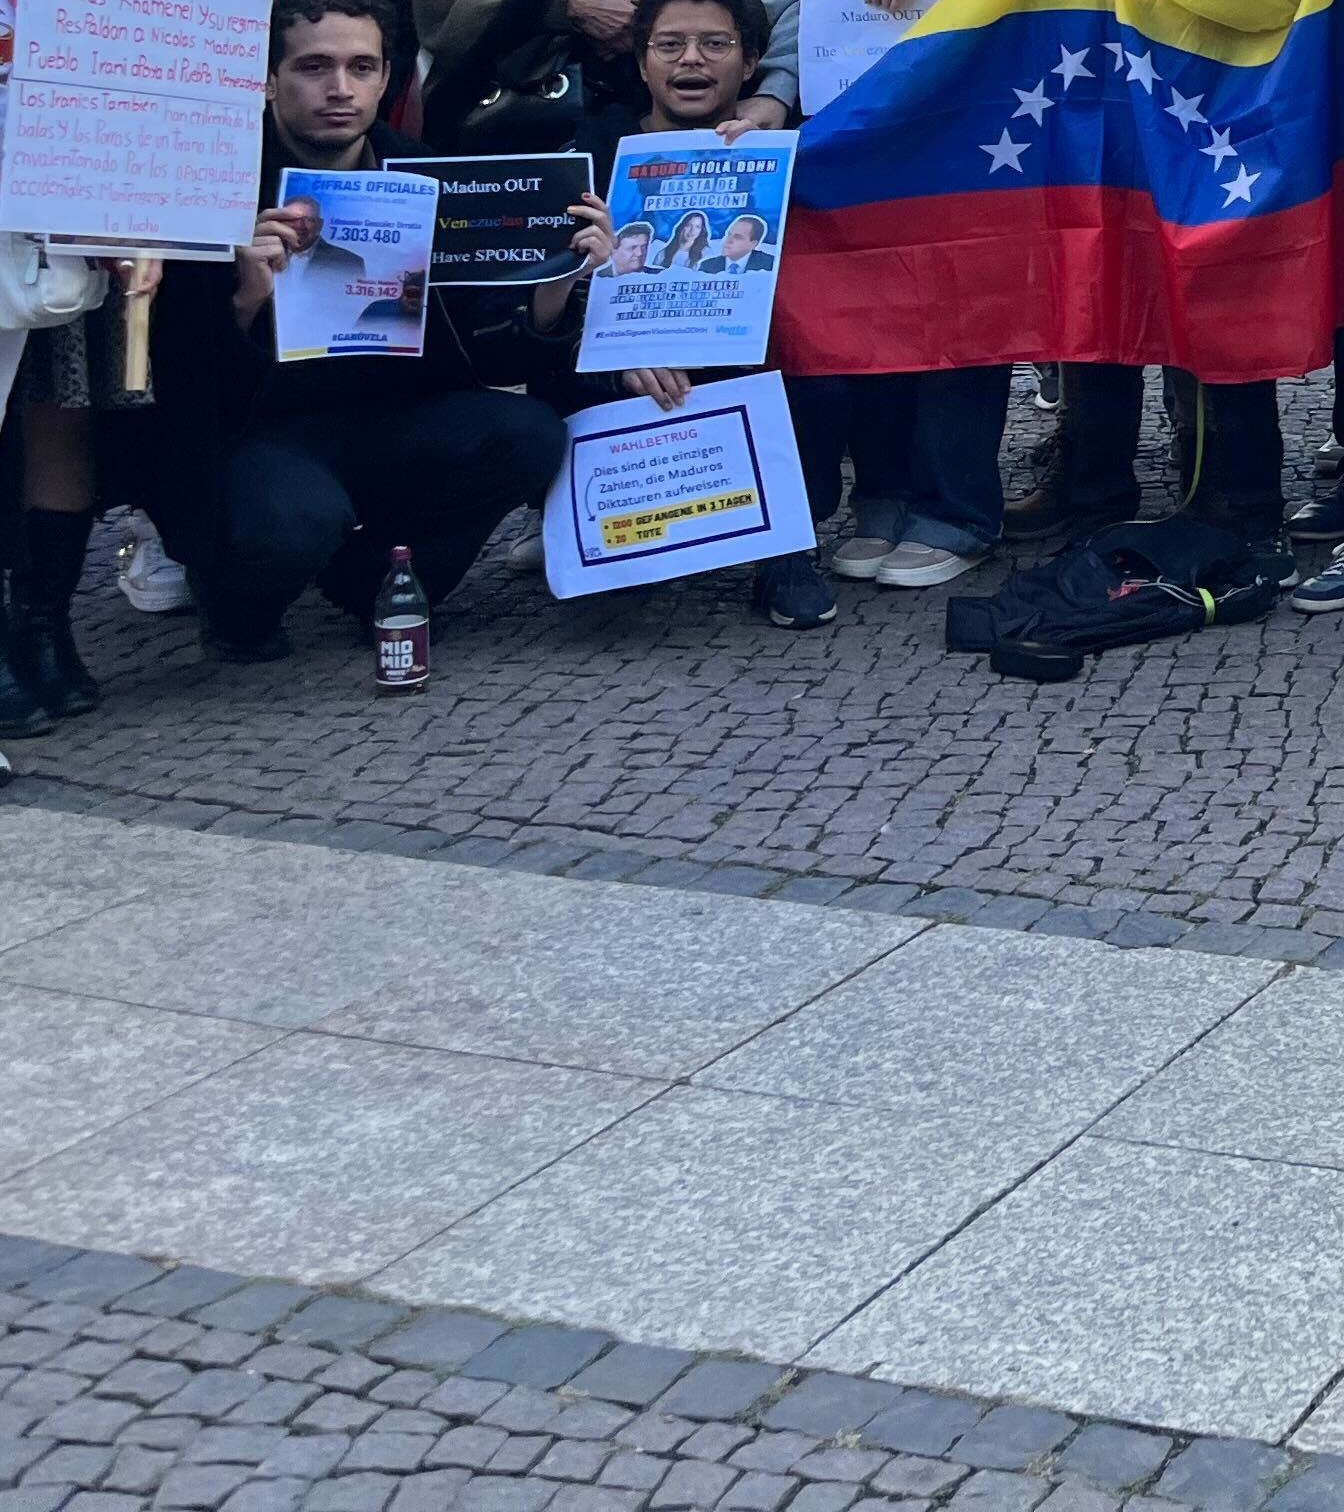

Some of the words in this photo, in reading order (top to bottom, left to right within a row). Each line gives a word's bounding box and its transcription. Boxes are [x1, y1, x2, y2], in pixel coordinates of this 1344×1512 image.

[840, 10, 889, 23] Maduro
[892, 8, 924, 21] OUT
[133, 26, 145, 43] a
[27, 40, 79, 72] Pueblo
[812, 45, 838, 58] The
[19, 82, 46, 108] Los
[690, 160, 732, 174] VIOLA
[313, 180, 361, 192] CIFRAS
[366, 181, 436, 196] OFICIALES
[442, 180, 501, 195] Maduro
[504, 177, 543, 192] OUT
[716, 177, 737, 192] DE
[438, 215, 524, 230] Venezuelan
[527, 212, 576, 229] people
[330, 226, 401, 244] 7.303.480
[431, 251, 470, 265] Have
[474, 248, 547, 263] SPOKEN
[345, 284, 398, 298] 3.316.142
[608, 427, 698, 455] WAHLBETRUG
[594, 466, 619, 479] Dies
[620, 459, 647, 473] sind
[649, 455, 670, 468] die
[671, 444, 724, 463] einzigen
[599, 479, 645, 495] Zahlen,
[645, 472, 666, 486] die
[667, 461, 724, 481] Maduros
[597, 491, 663, 512] Diktaturen
[664, 476, 733, 499] aufweisen:
[635, 506, 694, 526] GEFANGENE
[696, 502, 707, 513] IN
[717, 493, 753, 510] TAGEN
[635, 526, 663, 540] TOTE
[381, 640, 413, 655] MIO
[381, 654, 413, 668] MIO
